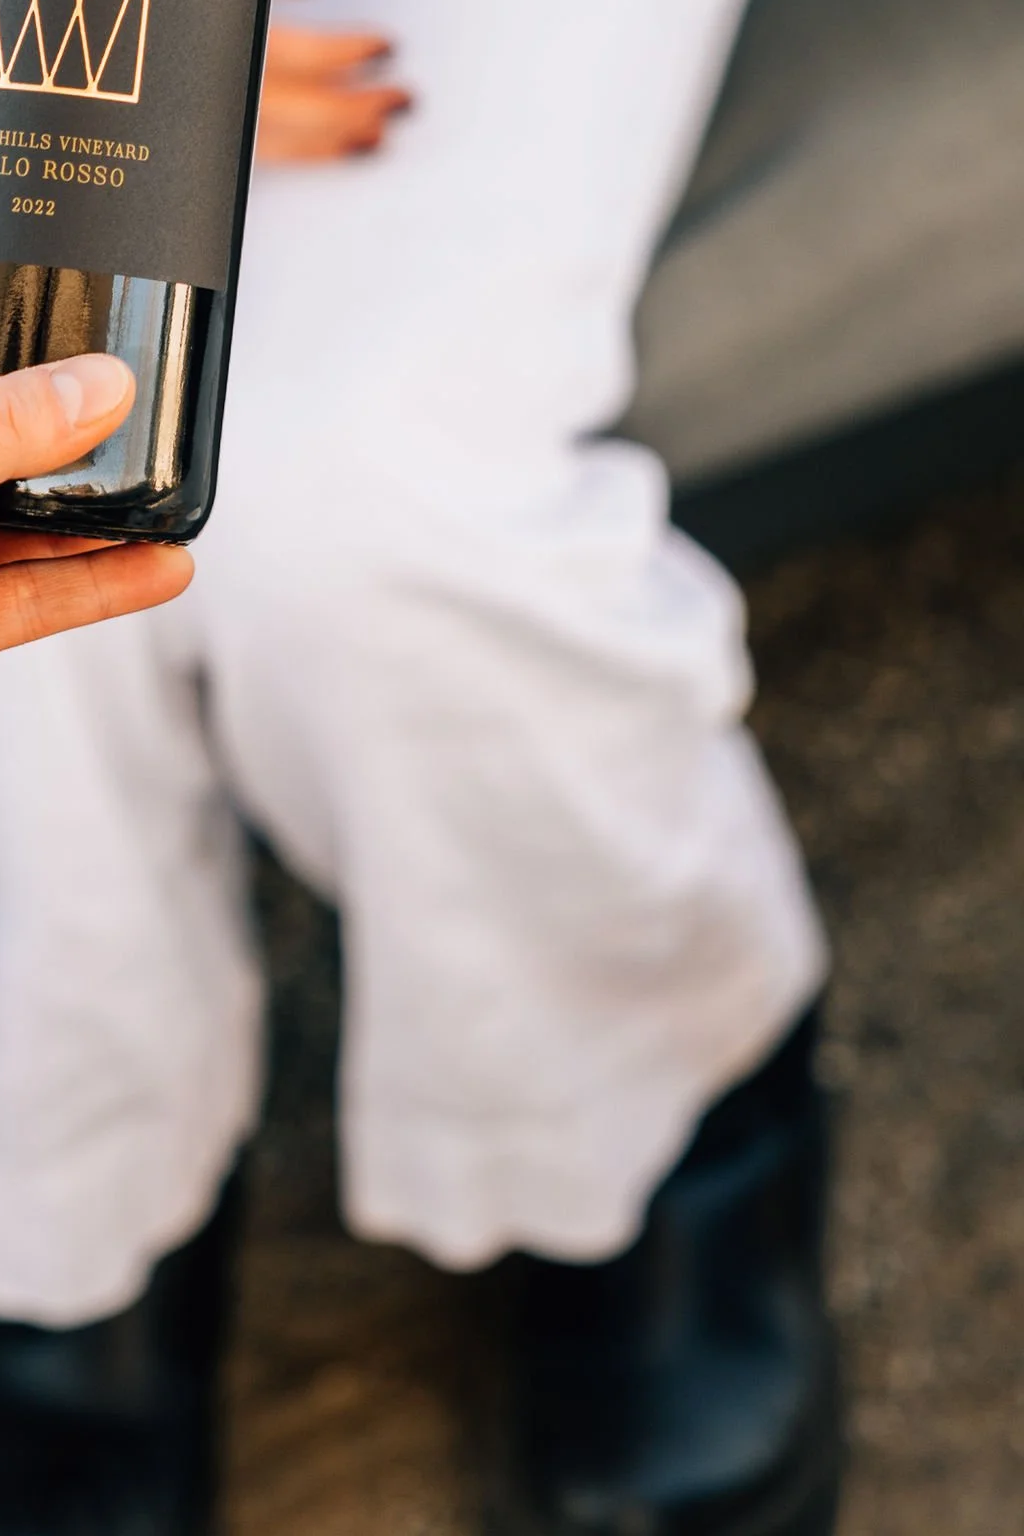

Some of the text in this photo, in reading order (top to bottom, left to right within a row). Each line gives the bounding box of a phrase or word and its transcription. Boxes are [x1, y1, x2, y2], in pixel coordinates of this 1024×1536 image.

[59, 135, 150, 161] VINEYARD
[42, 160, 125, 188] ROSSO
[11, 197, 56, 216] 2022
